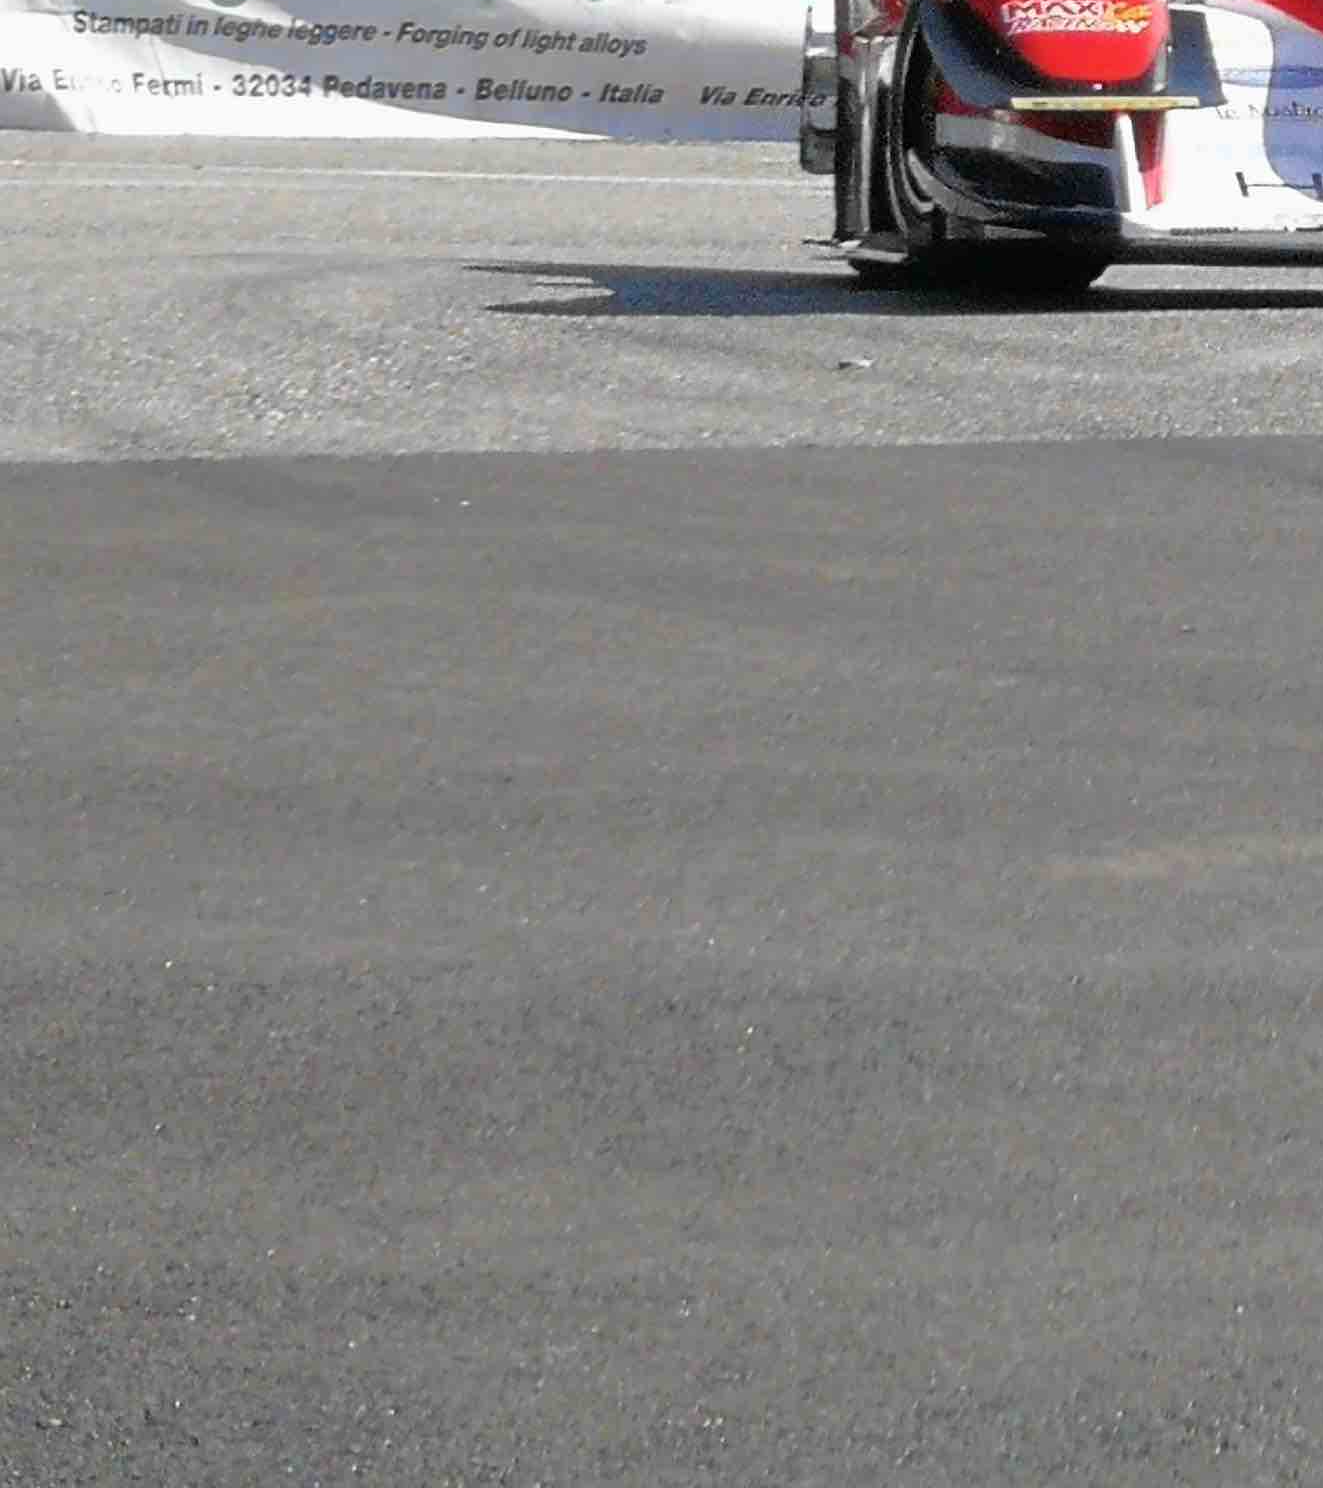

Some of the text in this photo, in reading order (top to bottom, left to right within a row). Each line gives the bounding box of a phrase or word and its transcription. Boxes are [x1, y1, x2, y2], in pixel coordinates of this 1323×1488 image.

[73, 10, 182, 37] Stampati
[186, 14, 209, 35] in
[214, 16, 280, 43] leghe
[287, 17, 378, 44] leggere
[400, 22, 488, 49] Forging
[495, 28, 522, 48] of
[522, 29, 577, 55] light
[580, 33, 647, 58] alloys
[1, 68, 42, 93] Via
[133, 72, 203, 97] Fermi
[232, 75, 312, 97] 32034
[322, 75, 447, 100] Pedavena
[475, 78, 573, 103] Belluno
[599, 83, 664, 105] Italia
[700, 85, 736, 106] Via
